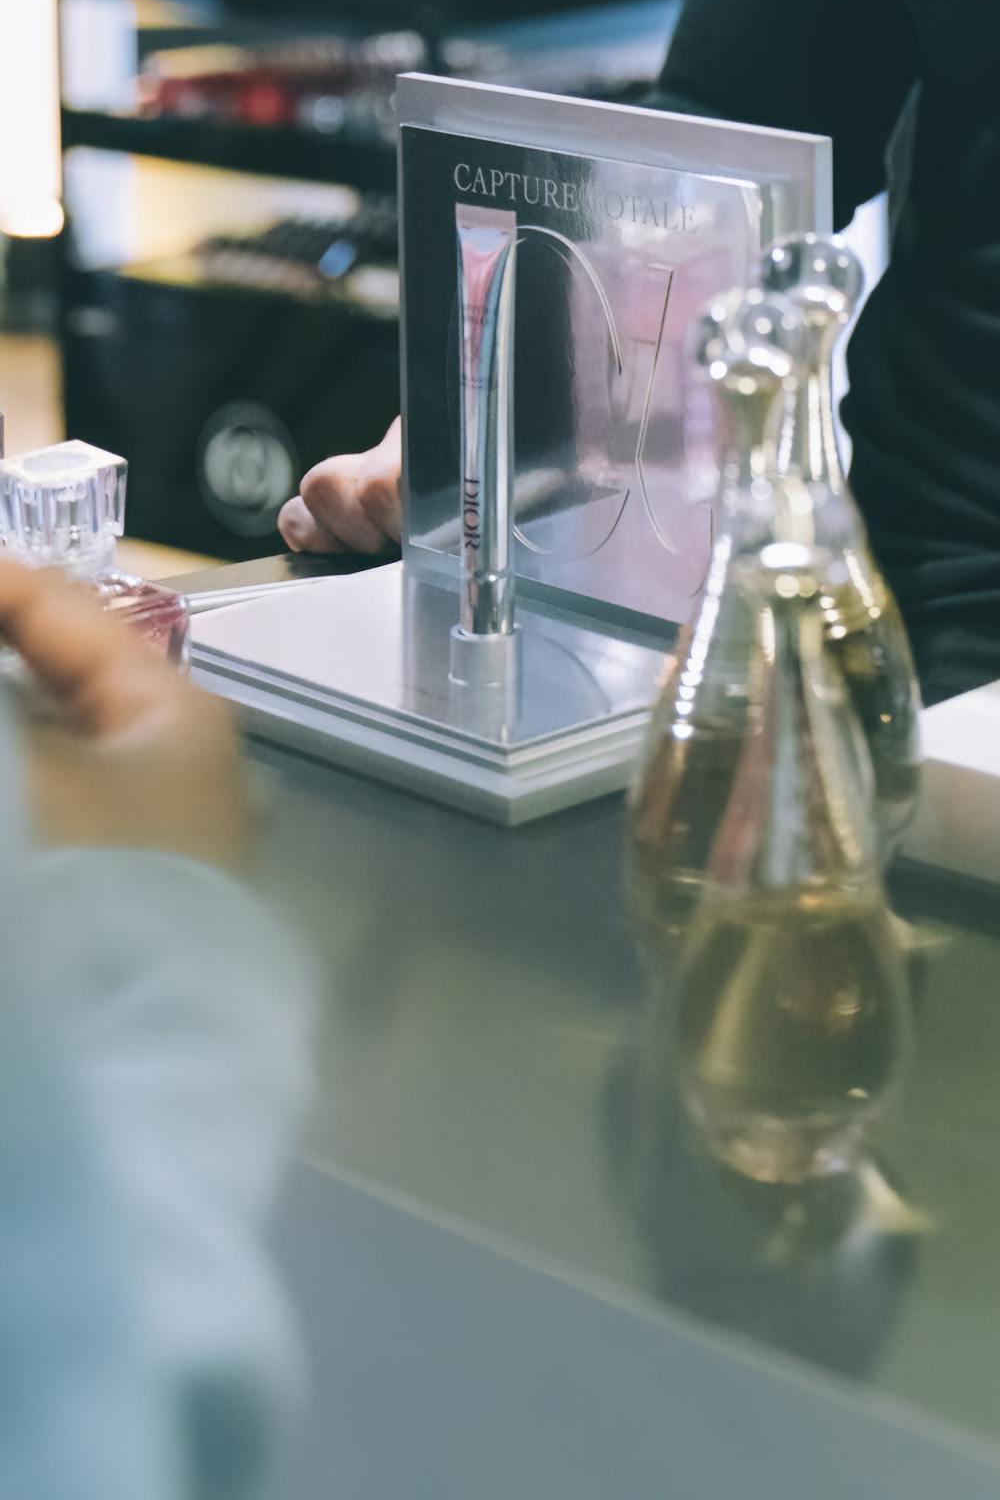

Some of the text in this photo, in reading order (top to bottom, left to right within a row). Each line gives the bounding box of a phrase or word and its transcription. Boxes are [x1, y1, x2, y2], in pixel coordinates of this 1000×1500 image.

[453, 163, 698, 234] CAPTURE OTALE
[463, 476, 480, 549] DIOR
